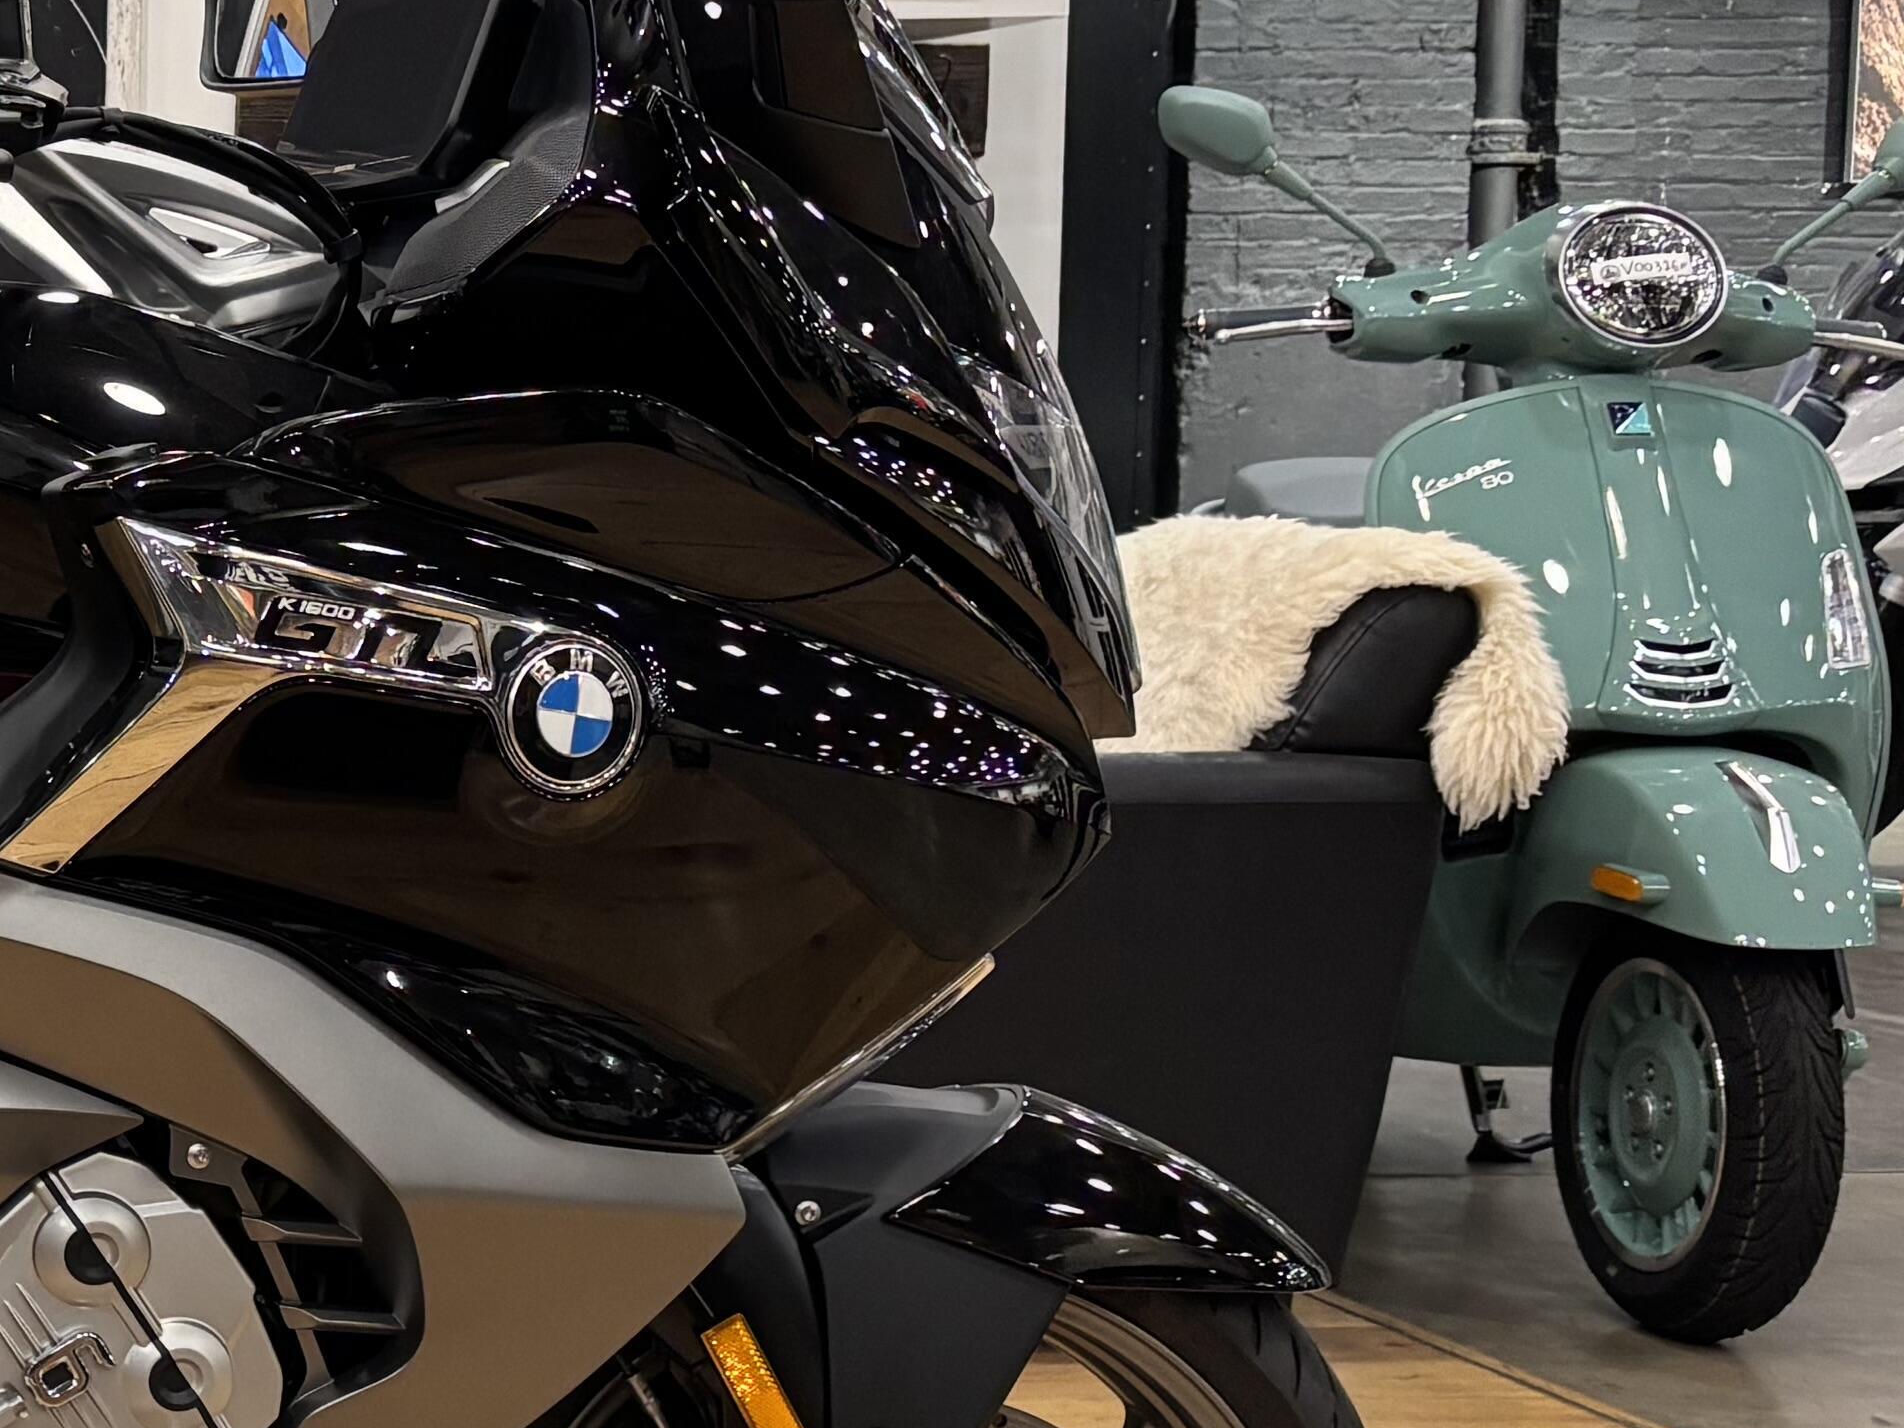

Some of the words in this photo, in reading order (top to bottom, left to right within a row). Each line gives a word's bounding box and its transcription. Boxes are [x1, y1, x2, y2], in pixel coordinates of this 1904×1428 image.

[278, 596, 297, 611] K
[298, 599, 356, 621] 1600
[530, 647, 630, 699] BMW
